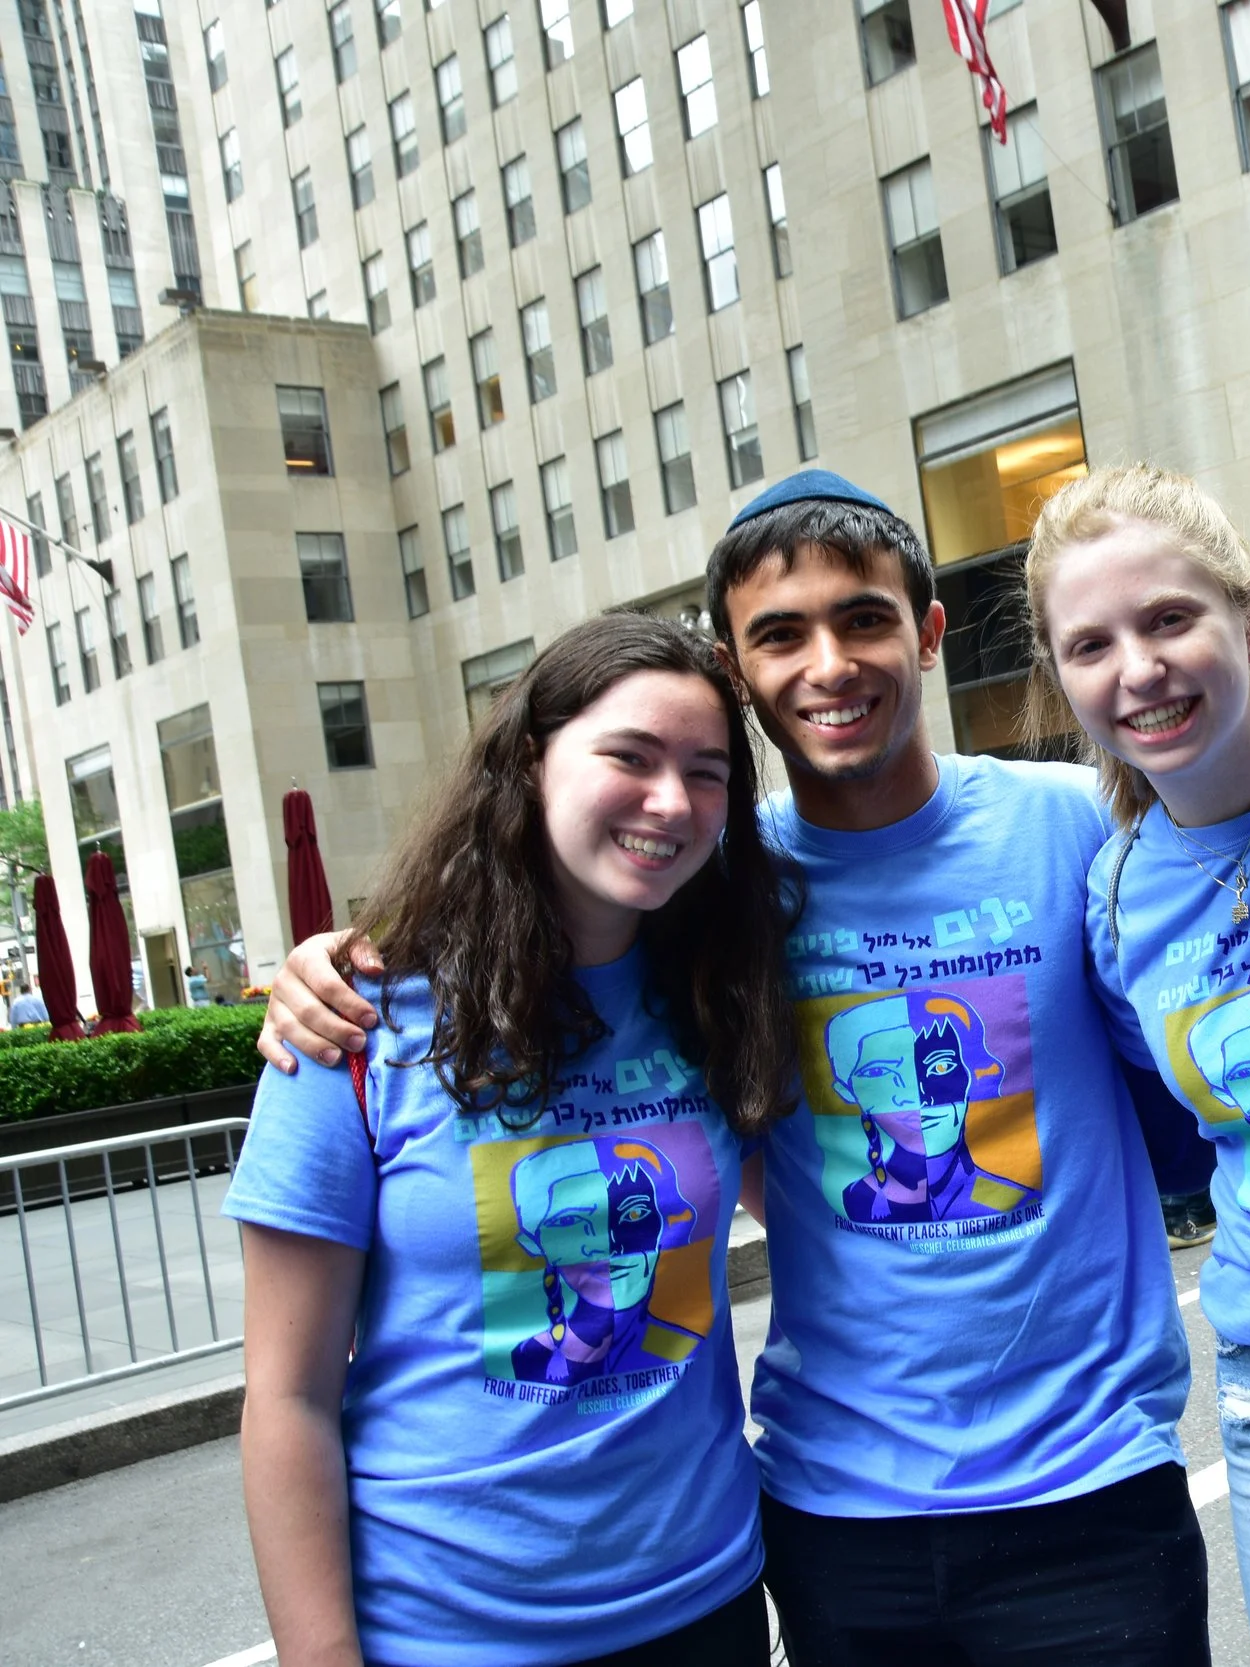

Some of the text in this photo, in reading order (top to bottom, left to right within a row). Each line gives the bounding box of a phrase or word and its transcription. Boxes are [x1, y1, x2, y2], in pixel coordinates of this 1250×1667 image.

[933, 897, 1033, 948] פנים
[863, 933, 897, 953] מול
[902, 932, 932, 950] אל
[857, 961, 886, 984] כך
[929, 945, 1042, 979] ממקומות
[1211, 962, 1235, 986] כך
[894, 964, 922, 988] כל
[592, 1072, 613, 1094] אל
[545, 1103, 574, 1126] כך
[580, 1108, 605, 1133] כל
[611, 1096, 710, 1127] ממקומות
[908, 1222, 952, 1240] PLACES,
[955, 1214, 1007, 1236] TOGETHER
[1010, 1210, 1022, 1226] AS
[1025, 1202, 1045, 1221] ONE
[946, 1234, 996, 1252] CELEBRATES
[997, 1228, 1024, 1244] ISRAEL
[1026, 1225, 1037, 1238] AT
[483, 1377, 516, 1399] FROM
[519, 1383, 577, 1406] DIFFERENT
[577, 1377, 622, 1399] PLACES,
[624, 1365, 681, 1391] TOGETHER
[577, 1397, 615, 1415] HESCHEL
